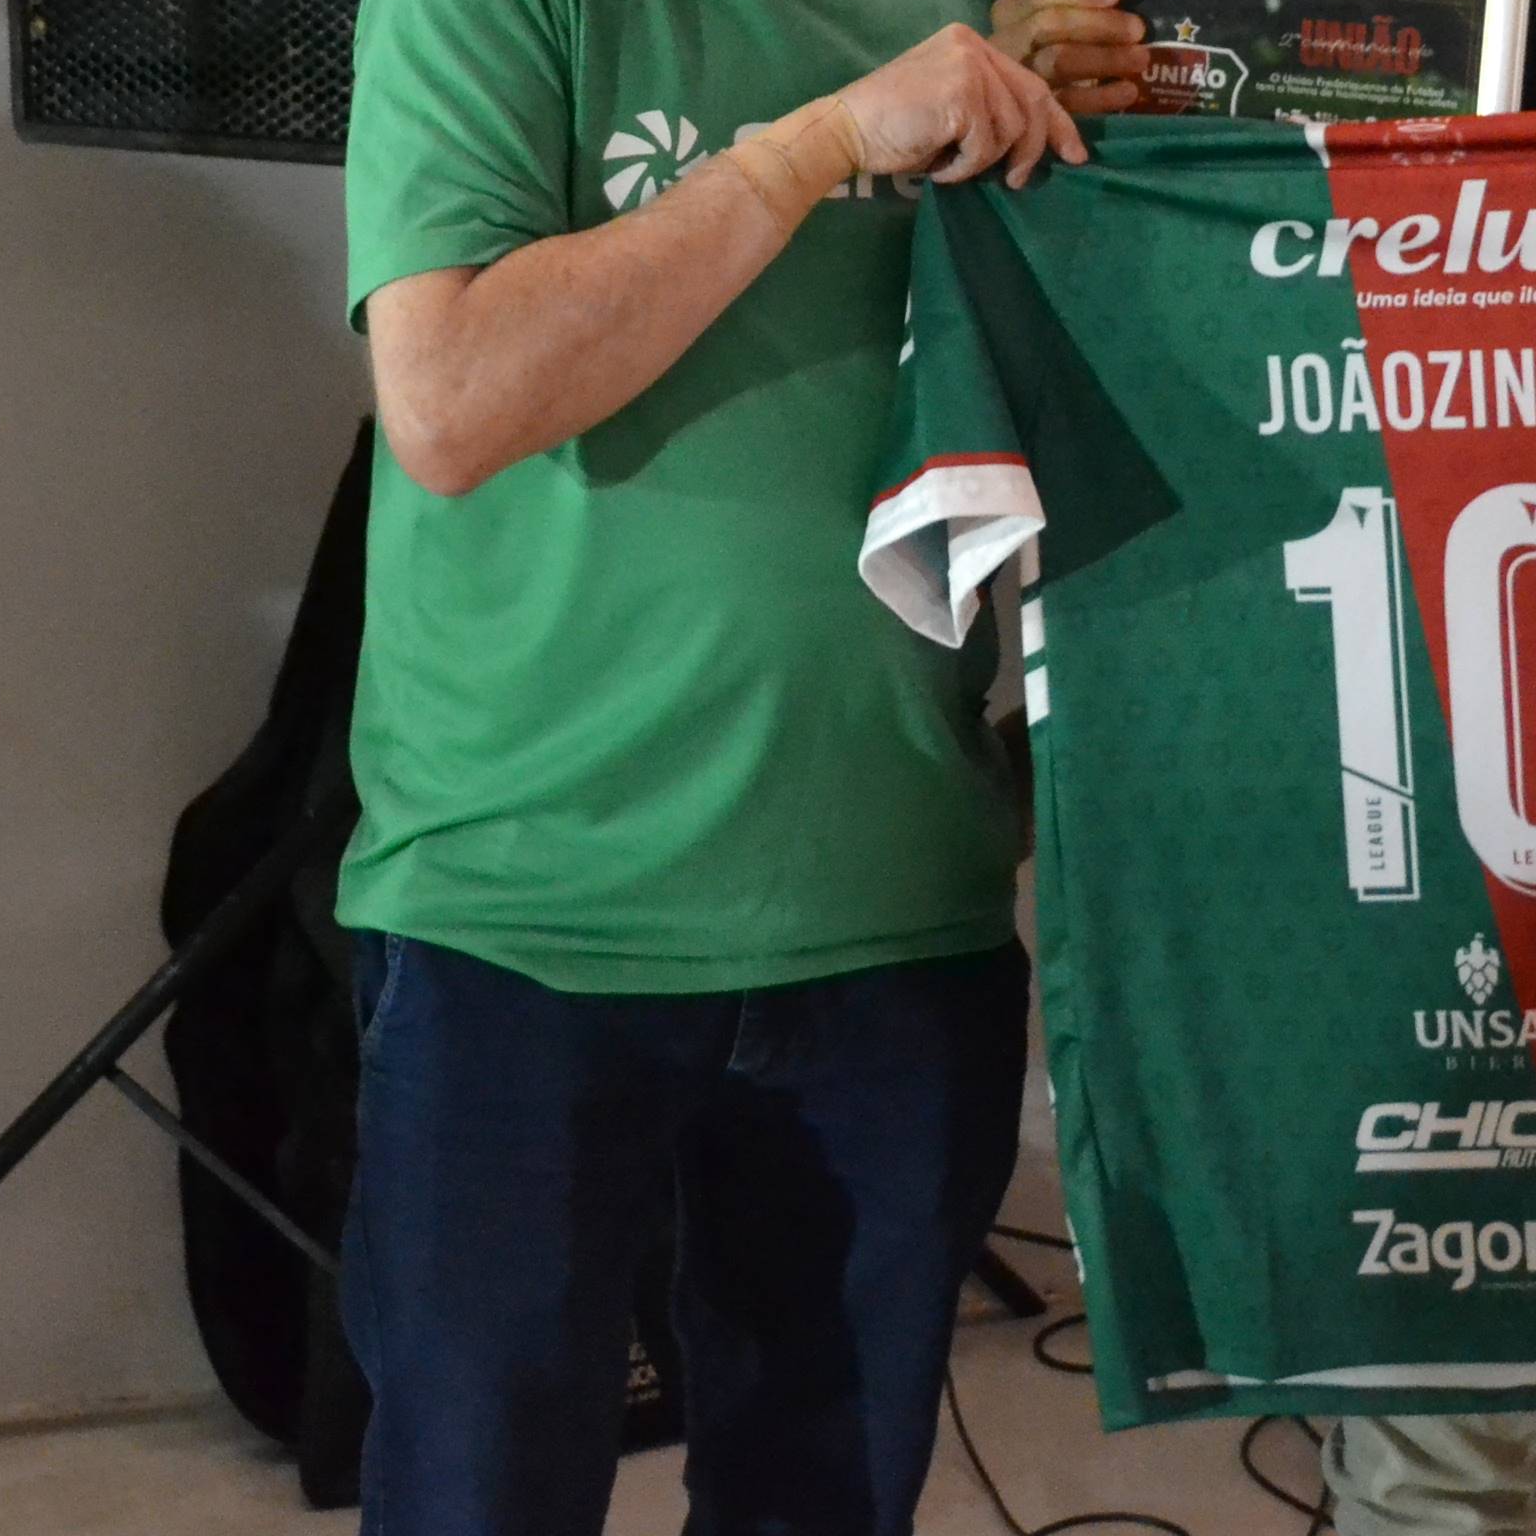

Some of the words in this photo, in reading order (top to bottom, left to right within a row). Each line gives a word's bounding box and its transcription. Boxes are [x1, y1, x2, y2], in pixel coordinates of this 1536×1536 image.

[1142, 63, 1227, 89] UNIÃO
[1356, 291, 1408, 309] Uma
[1413, 287, 1467, 308] ideia
[1472, 289, 1515, 310] que
[1366, 796, 1386, 871] LEAGUE
